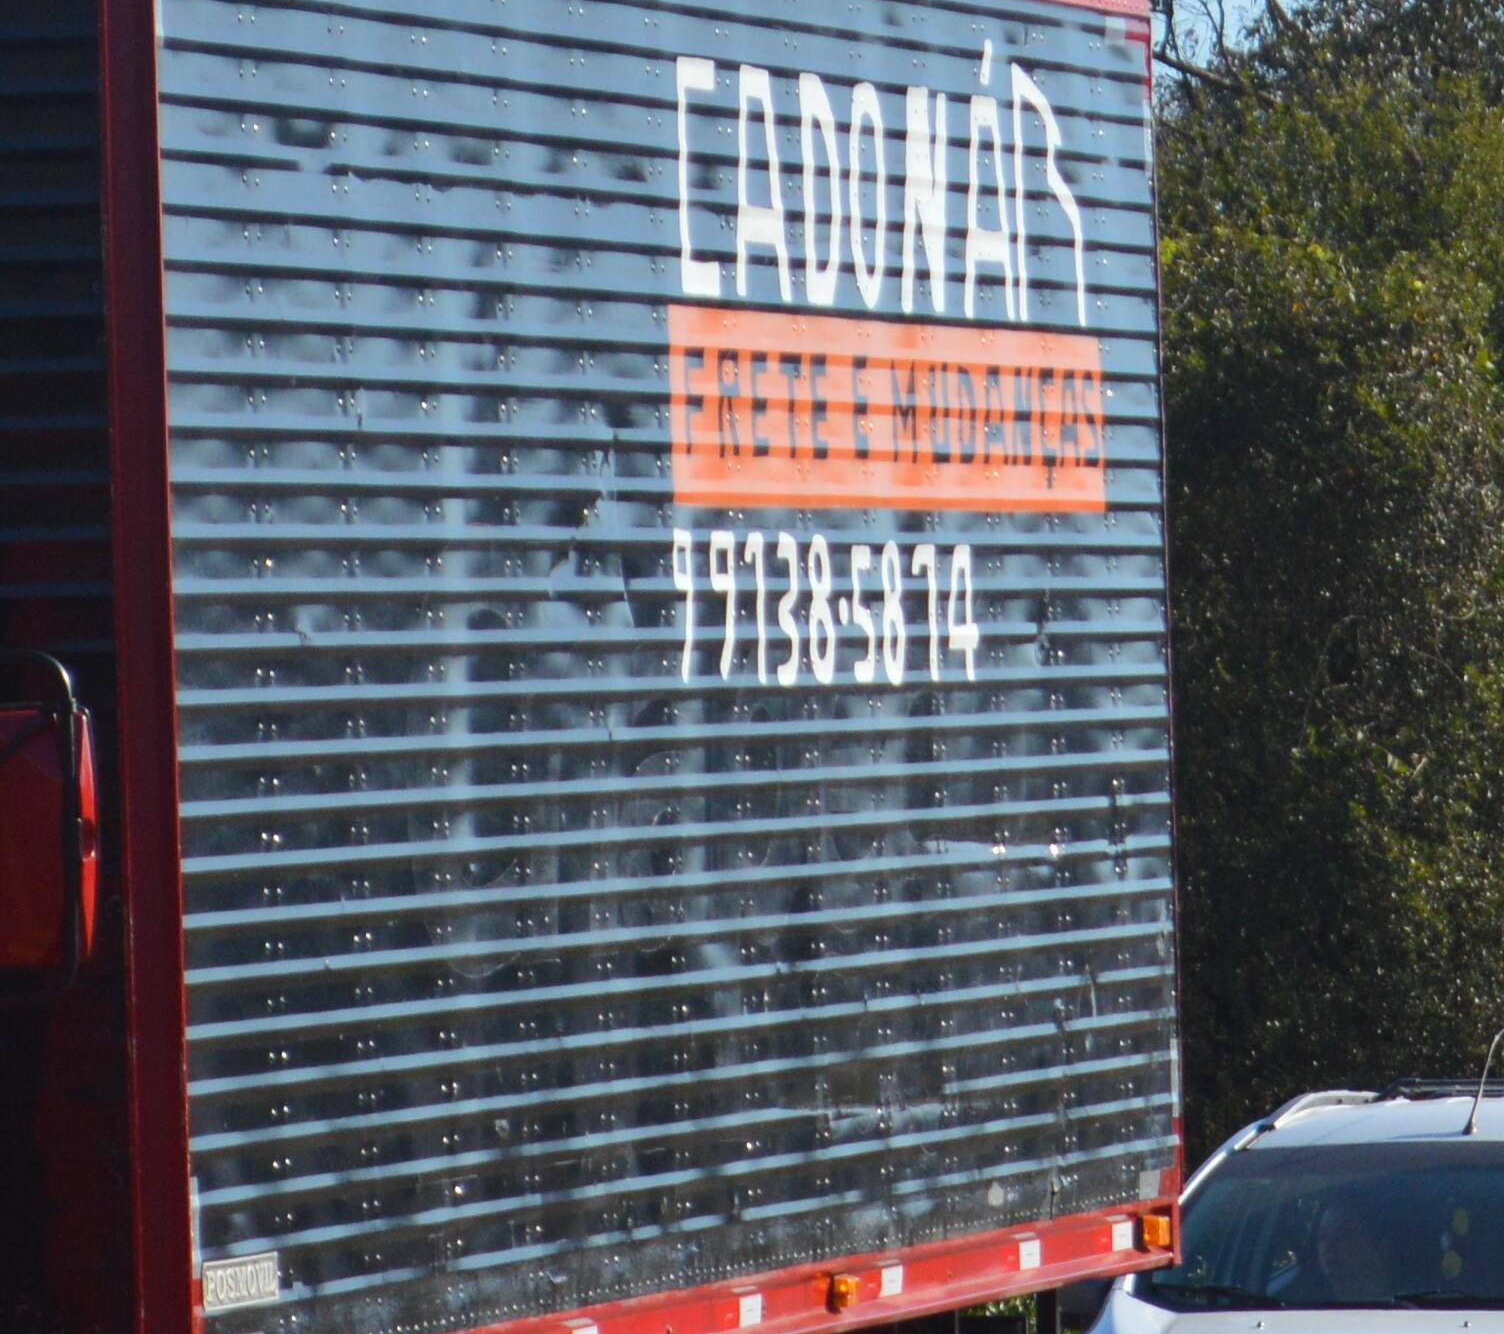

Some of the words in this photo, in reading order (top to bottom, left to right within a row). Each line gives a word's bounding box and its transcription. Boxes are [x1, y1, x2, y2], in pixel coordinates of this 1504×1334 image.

[684, 347, 829, 460] FRETE
[853, 354, 870, 460] E
[890, 359, 1104, 490] MUDANÇAS
[205, 1261, 276, 1303] POSMOVIL
